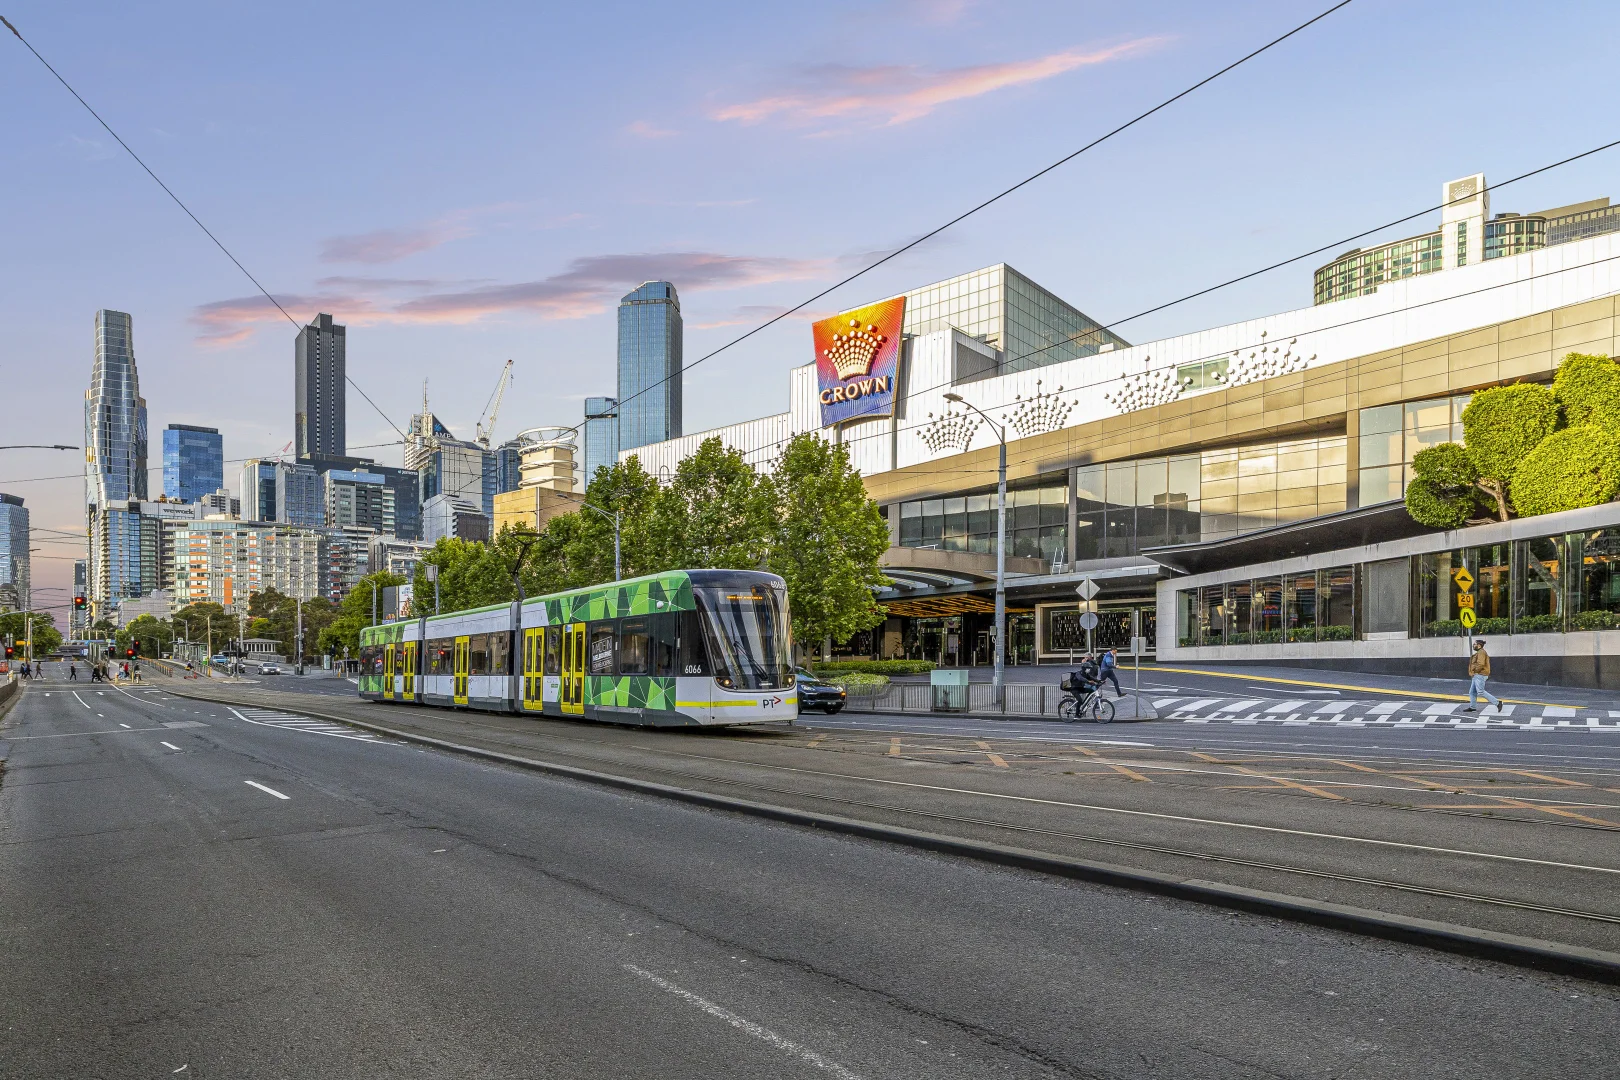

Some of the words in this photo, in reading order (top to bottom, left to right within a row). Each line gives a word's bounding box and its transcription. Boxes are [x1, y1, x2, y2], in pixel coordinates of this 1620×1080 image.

[820, 375, 889, 405] CROWN
[435, 431, 451, 439] AMP
[1461, 595, 1471, 603] 20
[685, 664, 702, 674] 6066
